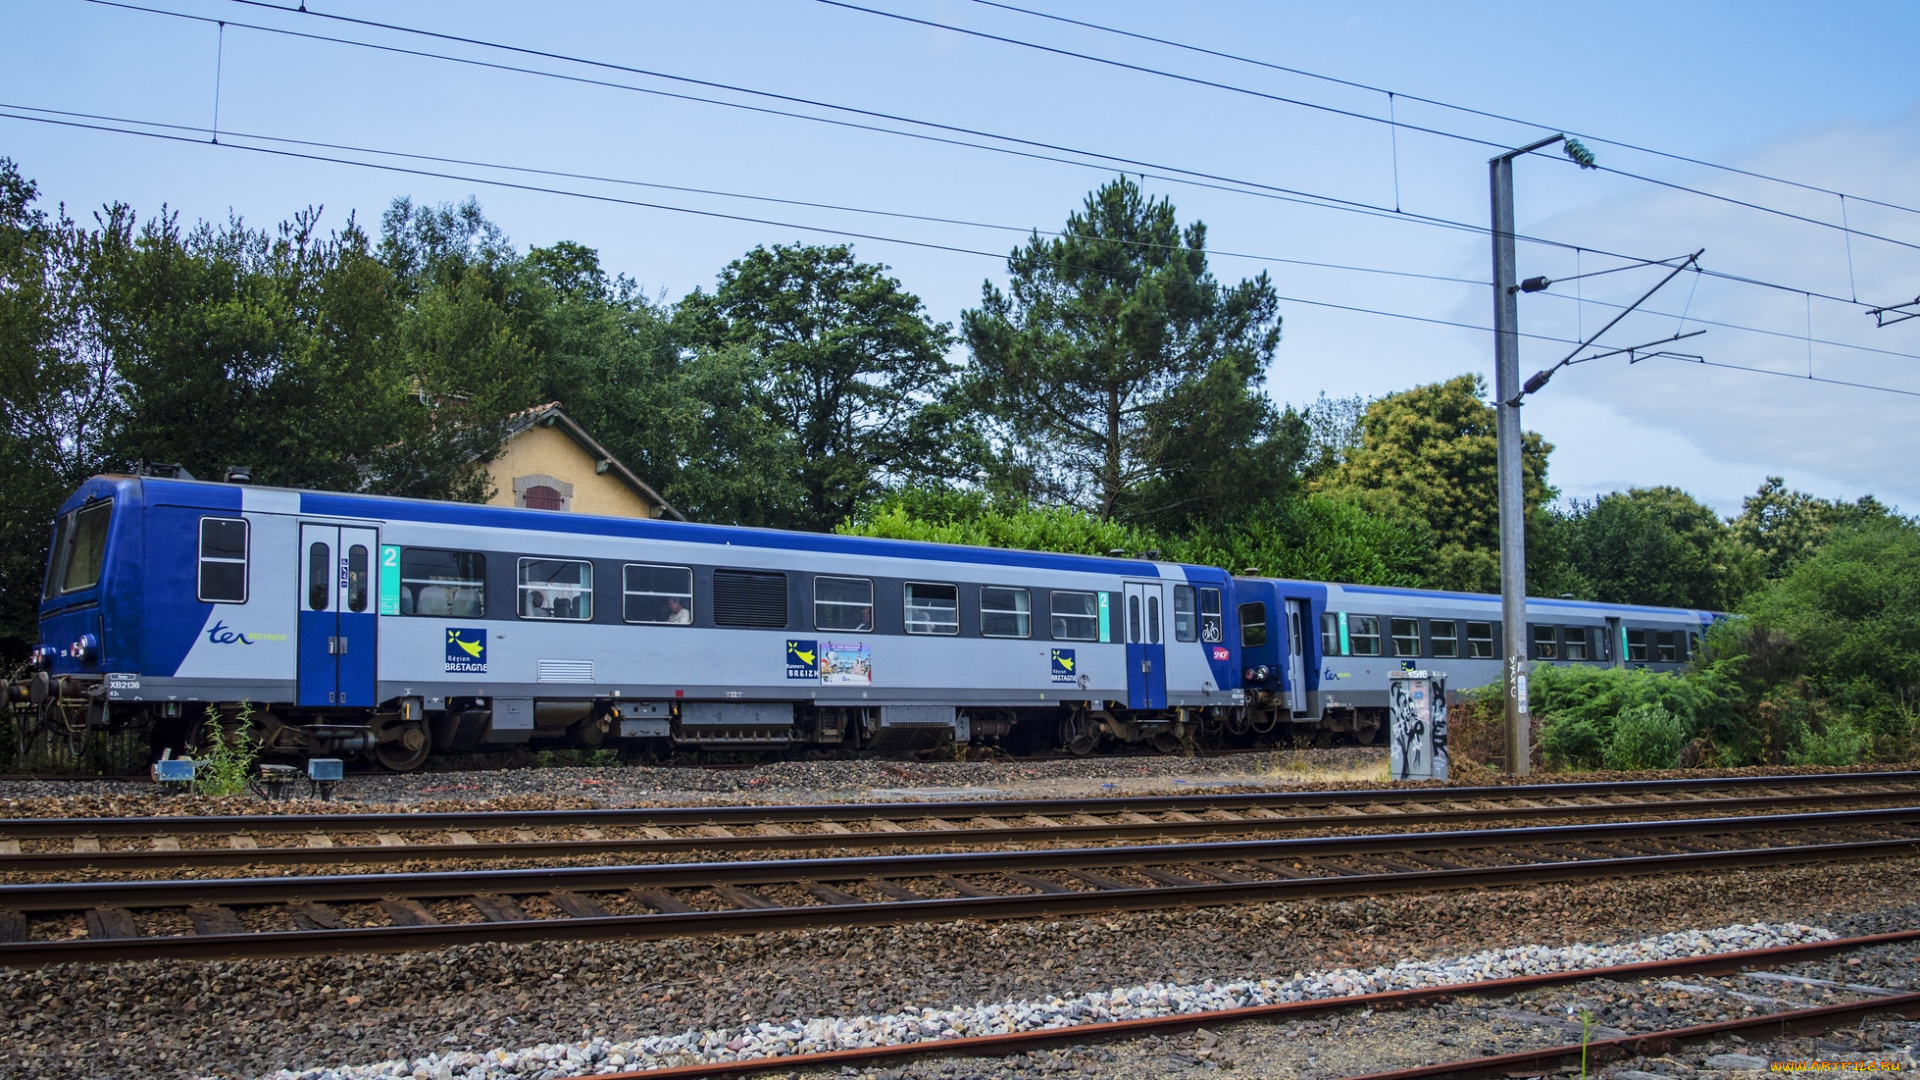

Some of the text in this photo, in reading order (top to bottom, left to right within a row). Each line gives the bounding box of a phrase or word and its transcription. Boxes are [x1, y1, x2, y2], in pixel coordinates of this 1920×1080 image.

[384, 547, 397, 567] 2
[1100, 594, 1107, 607] 2
[1340, 612, 1347, 625] 2
[207, 620, 255, 645] ter
[447, 655, 471, 663] Région
[1213, 651, 1228, 659] SNCF
[445, 662, 488, 672] BRETAGNE
[788, 669, 819, 677] BREIZH
[1324, 666, 1340, 681] ter
[110, 681, 140, 689] XB2136
